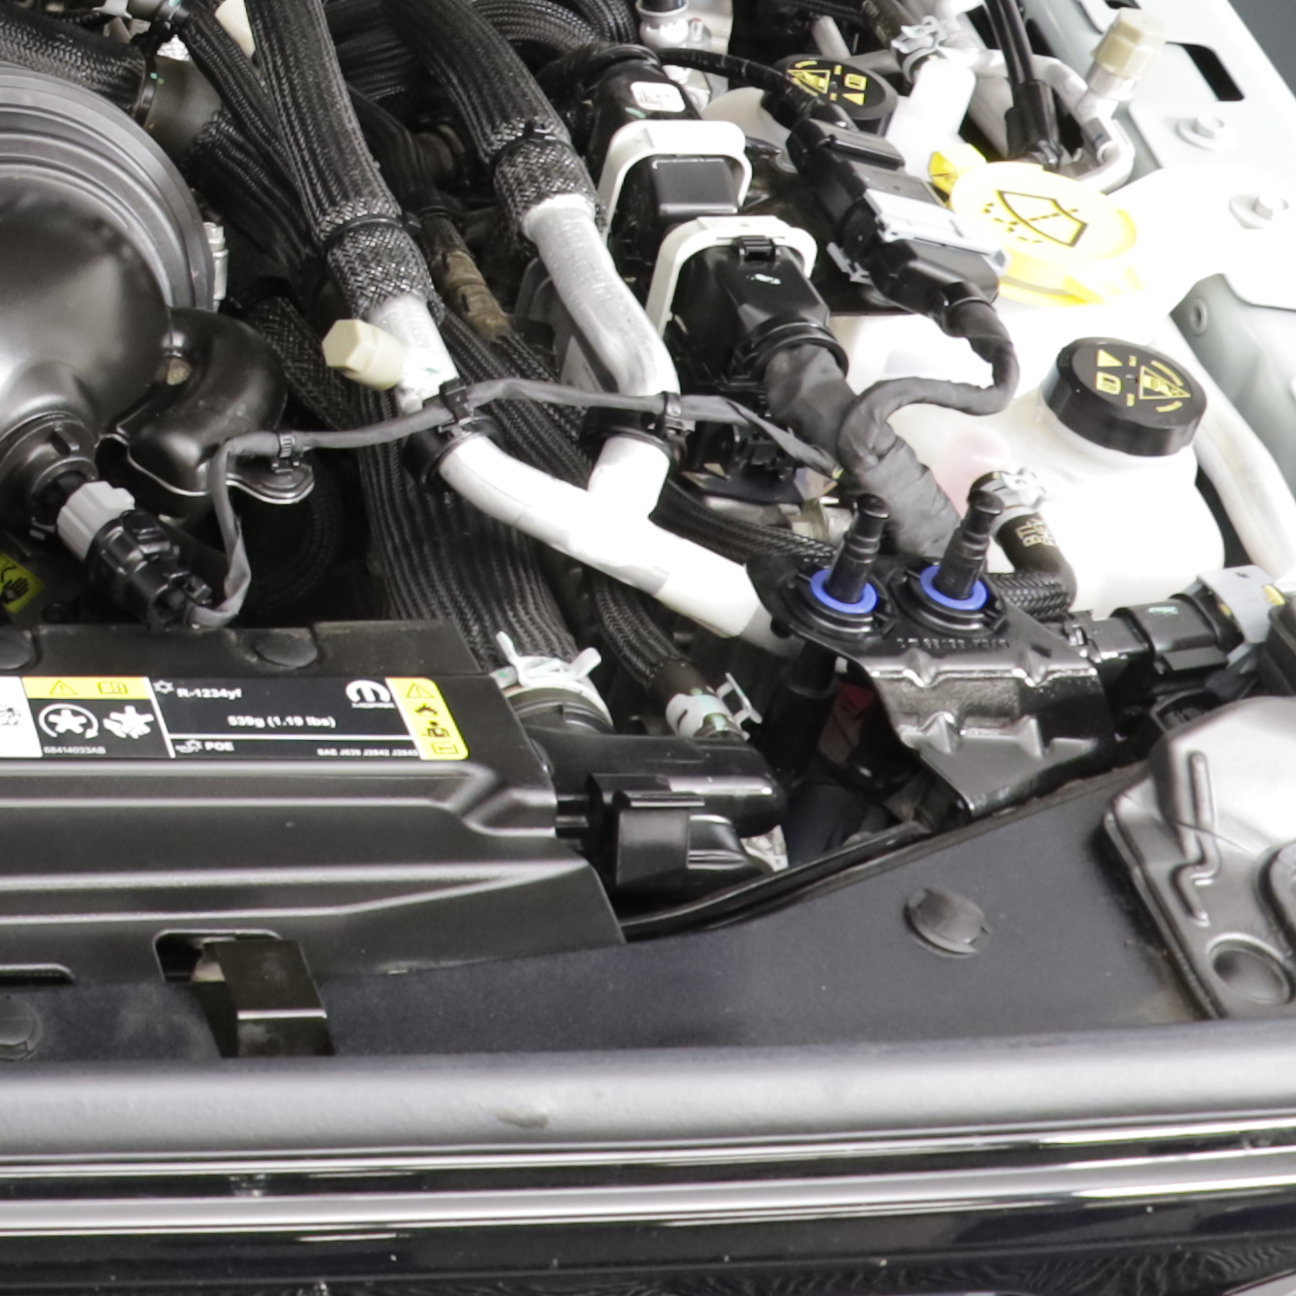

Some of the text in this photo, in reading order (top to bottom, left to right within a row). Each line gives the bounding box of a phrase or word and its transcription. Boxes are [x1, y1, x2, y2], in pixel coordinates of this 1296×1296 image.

[176, 687, 242, 700] R-1234yf
[227, 715, 266, 729] 539g
[306, 716, 337, 729] lbs)
[204, 740, 235, 752] POE
